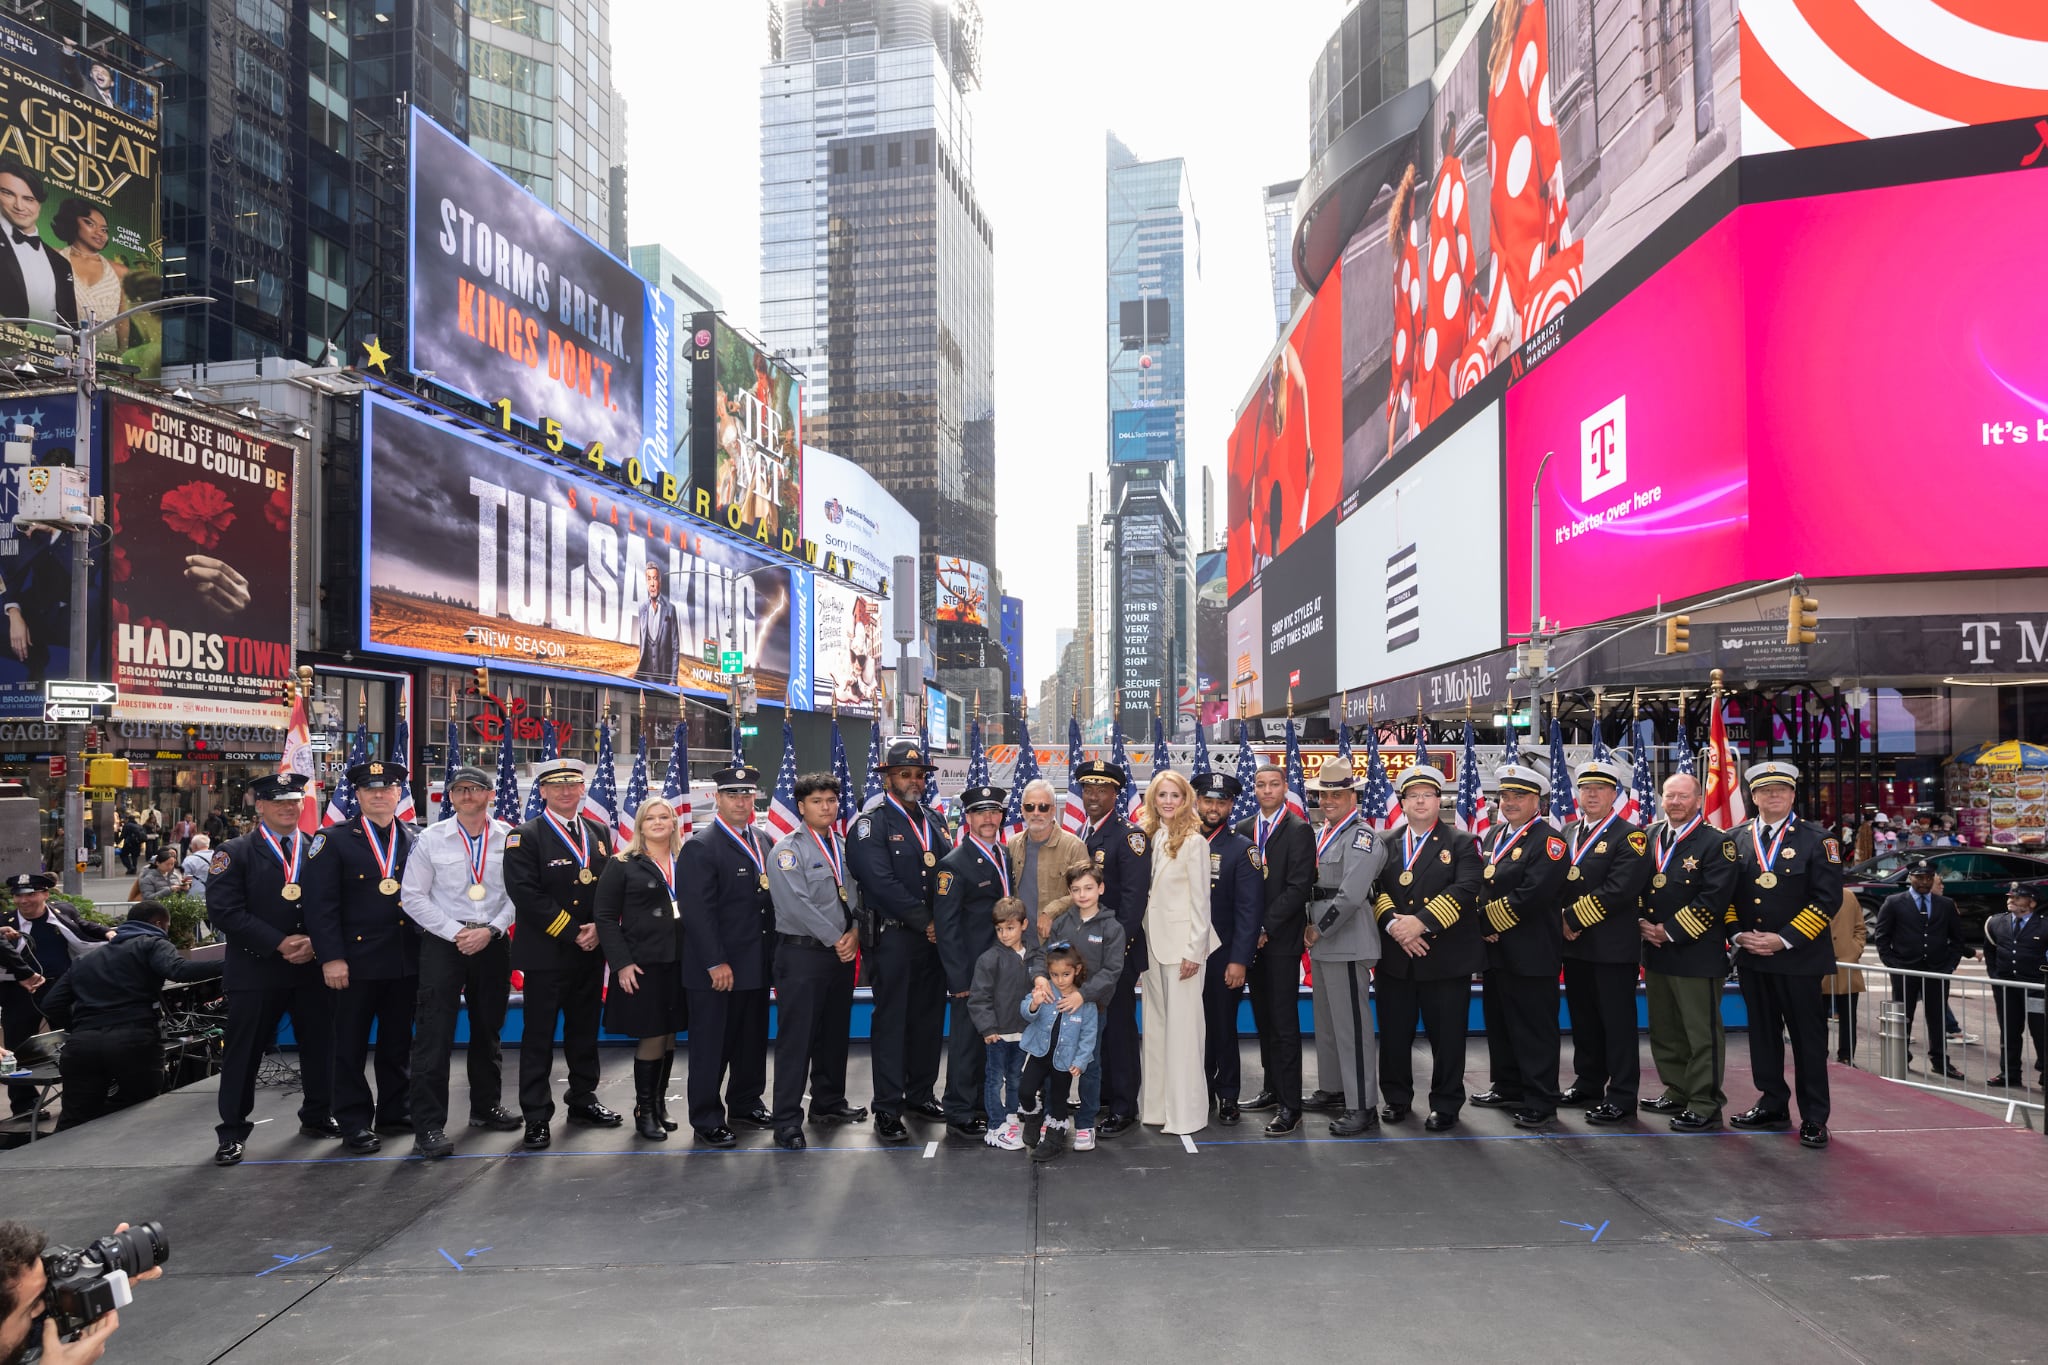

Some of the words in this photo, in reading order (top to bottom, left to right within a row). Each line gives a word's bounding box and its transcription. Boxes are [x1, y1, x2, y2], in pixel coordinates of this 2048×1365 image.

[6, 36, 37, 56] BLEU
[14, 72, 70, 103] ROARING
[74, 99, 92, 114] ON
[95, 110, 156, 142] BROADWAY
[20, 98, 156, 178] GREAT
[52, 180, 72, 190] NEW
[74, 190, 112, 208] MUSICAL
[117, 226, 142, 239] CHINA
[118, 234, 140, 245] ANNE
[440, 198, 550, 312] STORMS
[560, 274, 631, 364] BREAK.
[8, 326, 56, 344] BROADW
[28, 342, 36, 350] &
[458, 276, 538, 368] KINGS
[548, 330, 618, 412] DON'T.
[1526, 314, 1564, 354] MARRIOTT
[696, 350, 710, 360] LG
[1526, 334, 1560, 368] MARQUIS
[738, 388, 784, 458] THE
[1982, 422, 2028, 446] It's
[152, 412, 186, 439] COME
[190, 424, 212, 447] SEE
[218, 432, 242, 454] HOW
[246, 442, 266, 463] THE
[124, 424, 196, 464] WORLD
[202, 448, 261, 484] COULD
[266, 468, 286, 492] BE
[568, 488, 702, 555] STALLONE
[1556, 525, 1570, 544] It's
[1572, 512, 1603, 538] better
[1606, 502, 1632, 522] over
[1634, 486, 1662, 510] here
[826, 534, 848, 552] Sorry
[469, 476, 649, 644] TULSA
[667, 547, 756, 668] KING
[1124, 604, 1146, 612] THIS
[1148, 602, 1158, 611] IS
[1272, 618, 1284, 637] SHOP
[1284, 613, 1294, 630] NYC
[1294, 601, 1312, 624] STYLES
[1314, 596, 1322, 614] AT
[1124, 625, 1150, 634] VERY,
[1124, 636, 1148, 644] VERY
[1286, 627, 1301, 646] TIMES
[1302, 615, 1324, 640] SQUARE
[118, 623, 290, 678] HADESTOWN
[478, 629, 512, 650] NEW
[514, 635, 566, 658] SEASON
[1124, 647, 1148, 655] TALL
[1962, 622, 2001, 664] T
[118, 665, 192, 681] BROADWAY'S
[195, 672, 235, 684] GLOBAL
[237, 676, 289, 689] SENSATIO
[118, 678, 150, 686] AMSTERDAM
[176, 682, 204, 690] MELBOURNE
[692, 668, 712, 682] NOW
[1125, 679, 1161, 688] SECURE
[1446, 665, 1491, 701] Mobile
[1125, 690, 1150, 698] YOUR
[1125, 702, 1152, 710] DATA.
[51, 708, 64, 716] ONE
[120, 722, 183, 740] GIFTS
[200, 726, 286, 744] LUGGAGE
[156, 751, 182, 760] Nikon
[188, 752, 220, 760] Canon
[1379, 754, 1416, 768] 343
